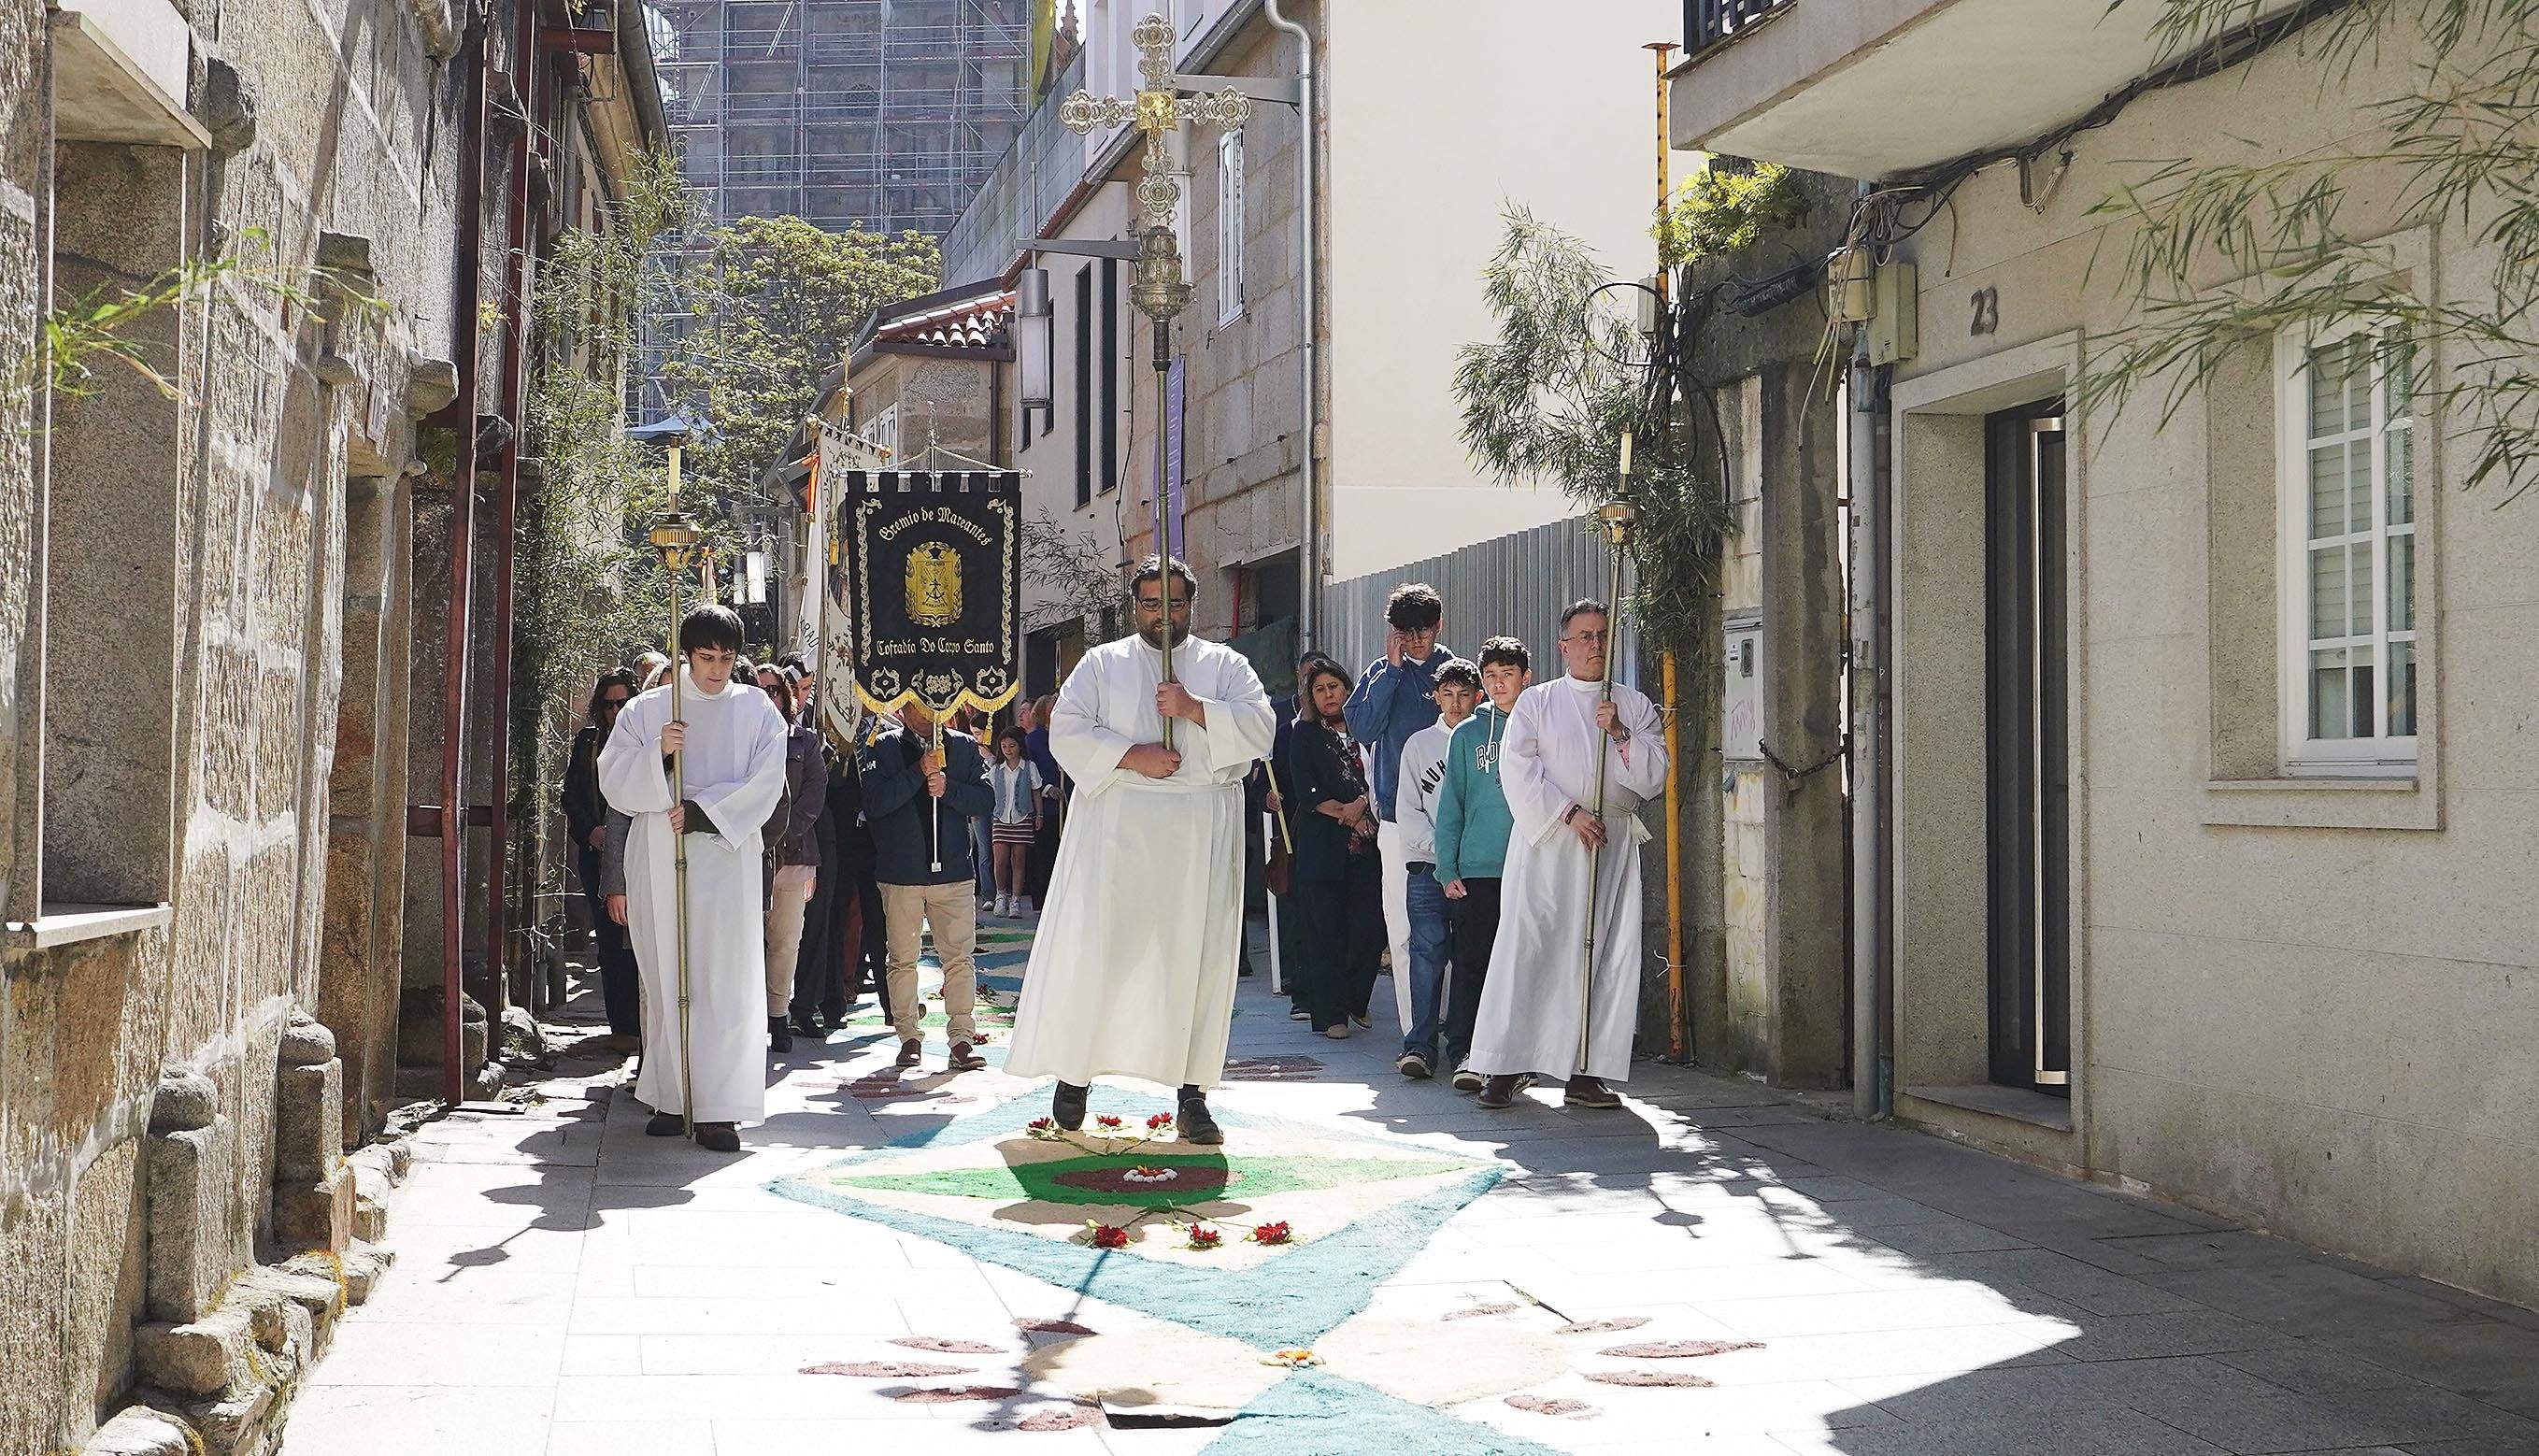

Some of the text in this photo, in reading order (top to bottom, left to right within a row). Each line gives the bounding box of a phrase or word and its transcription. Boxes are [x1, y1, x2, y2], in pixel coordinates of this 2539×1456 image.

[1971, 285, 1998, 336] 23
[878, 506, 993, 546] Gremio de Mareantes
[877, 638, 917, 658] Cofradía
[920, 636, 935, 653] Do
[963, 637, 994, 654] Santo
